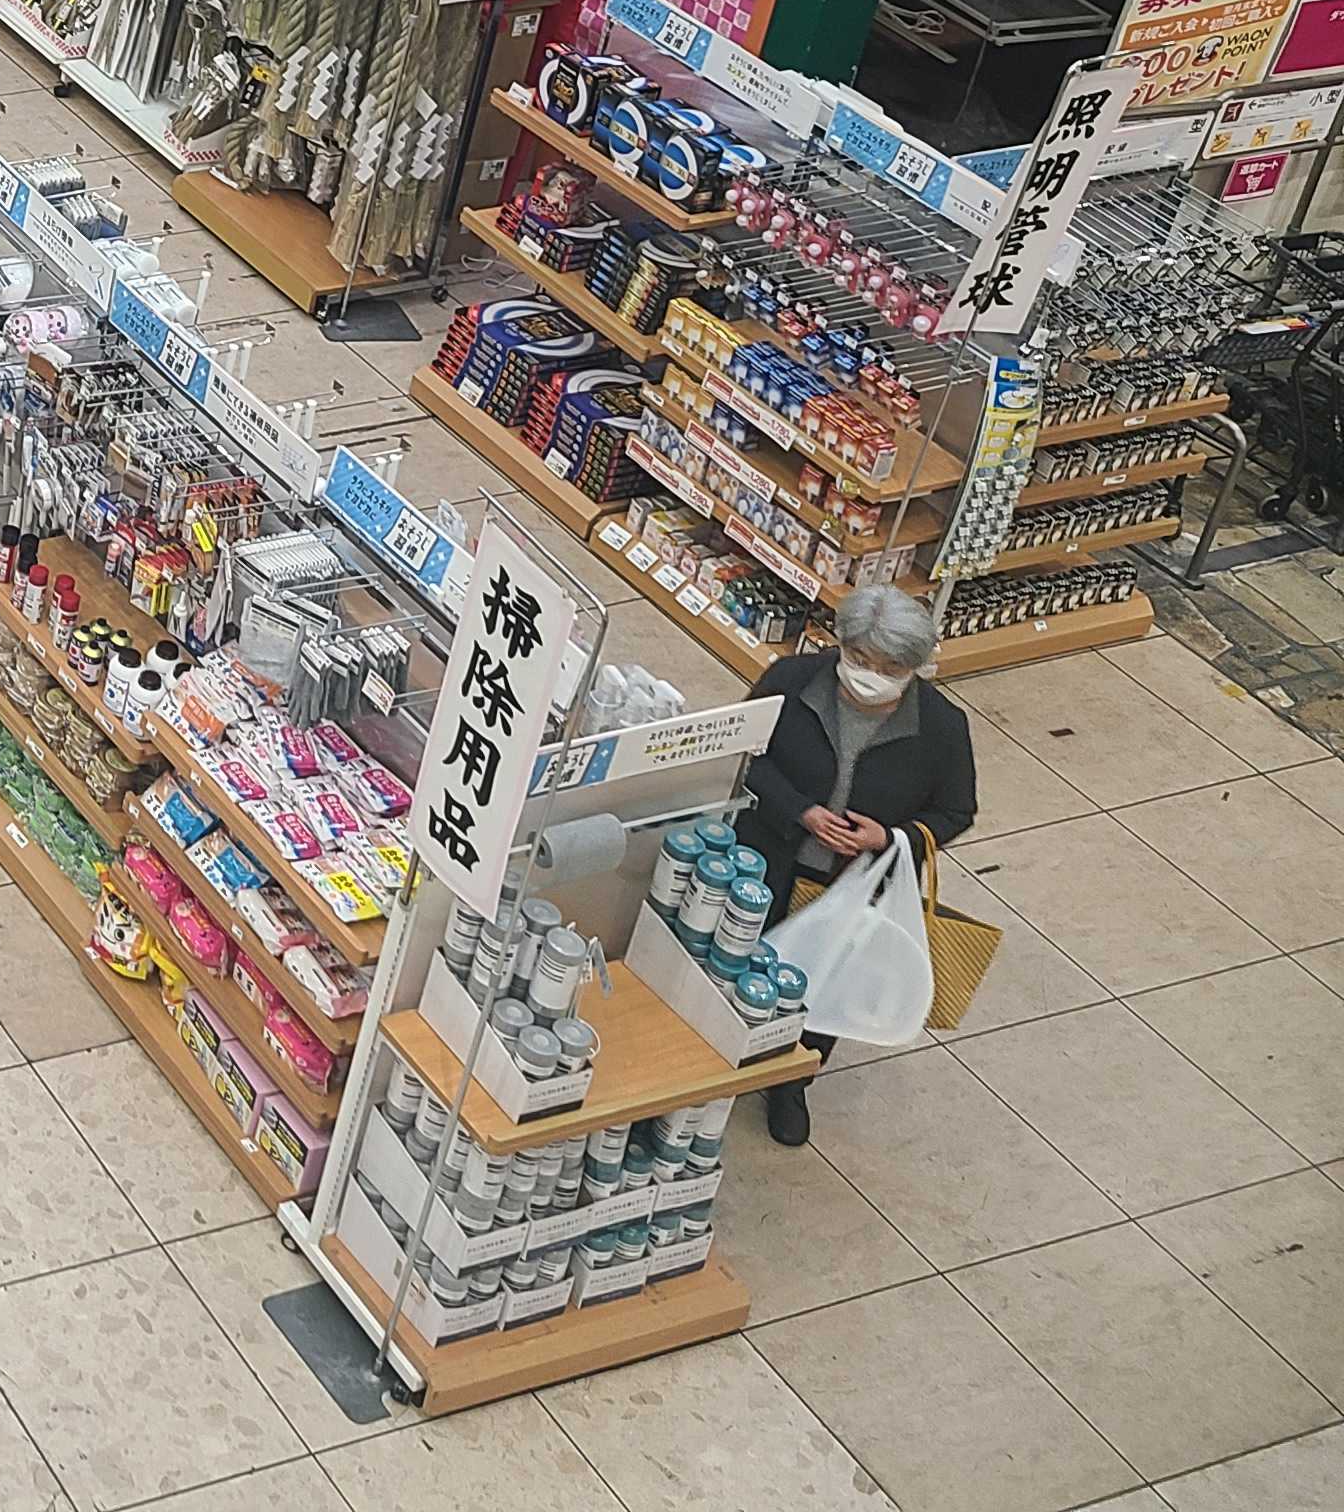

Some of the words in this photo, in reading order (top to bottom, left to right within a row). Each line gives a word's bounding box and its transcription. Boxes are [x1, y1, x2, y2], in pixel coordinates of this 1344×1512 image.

[666, 18, 692, 43] おそうじ
[1226, 25, 1274, 47] WAON
[1221, 38, 1268, 61] POINT
[899, 150, 928, 177] おそうじ
[958, 89, 1112, 314] 照明管球
[166, 338, 192, 368] おそうじ
[398, 518, 431, 552] おそうじ
[428, 564, 543, 874] 掃除用品
